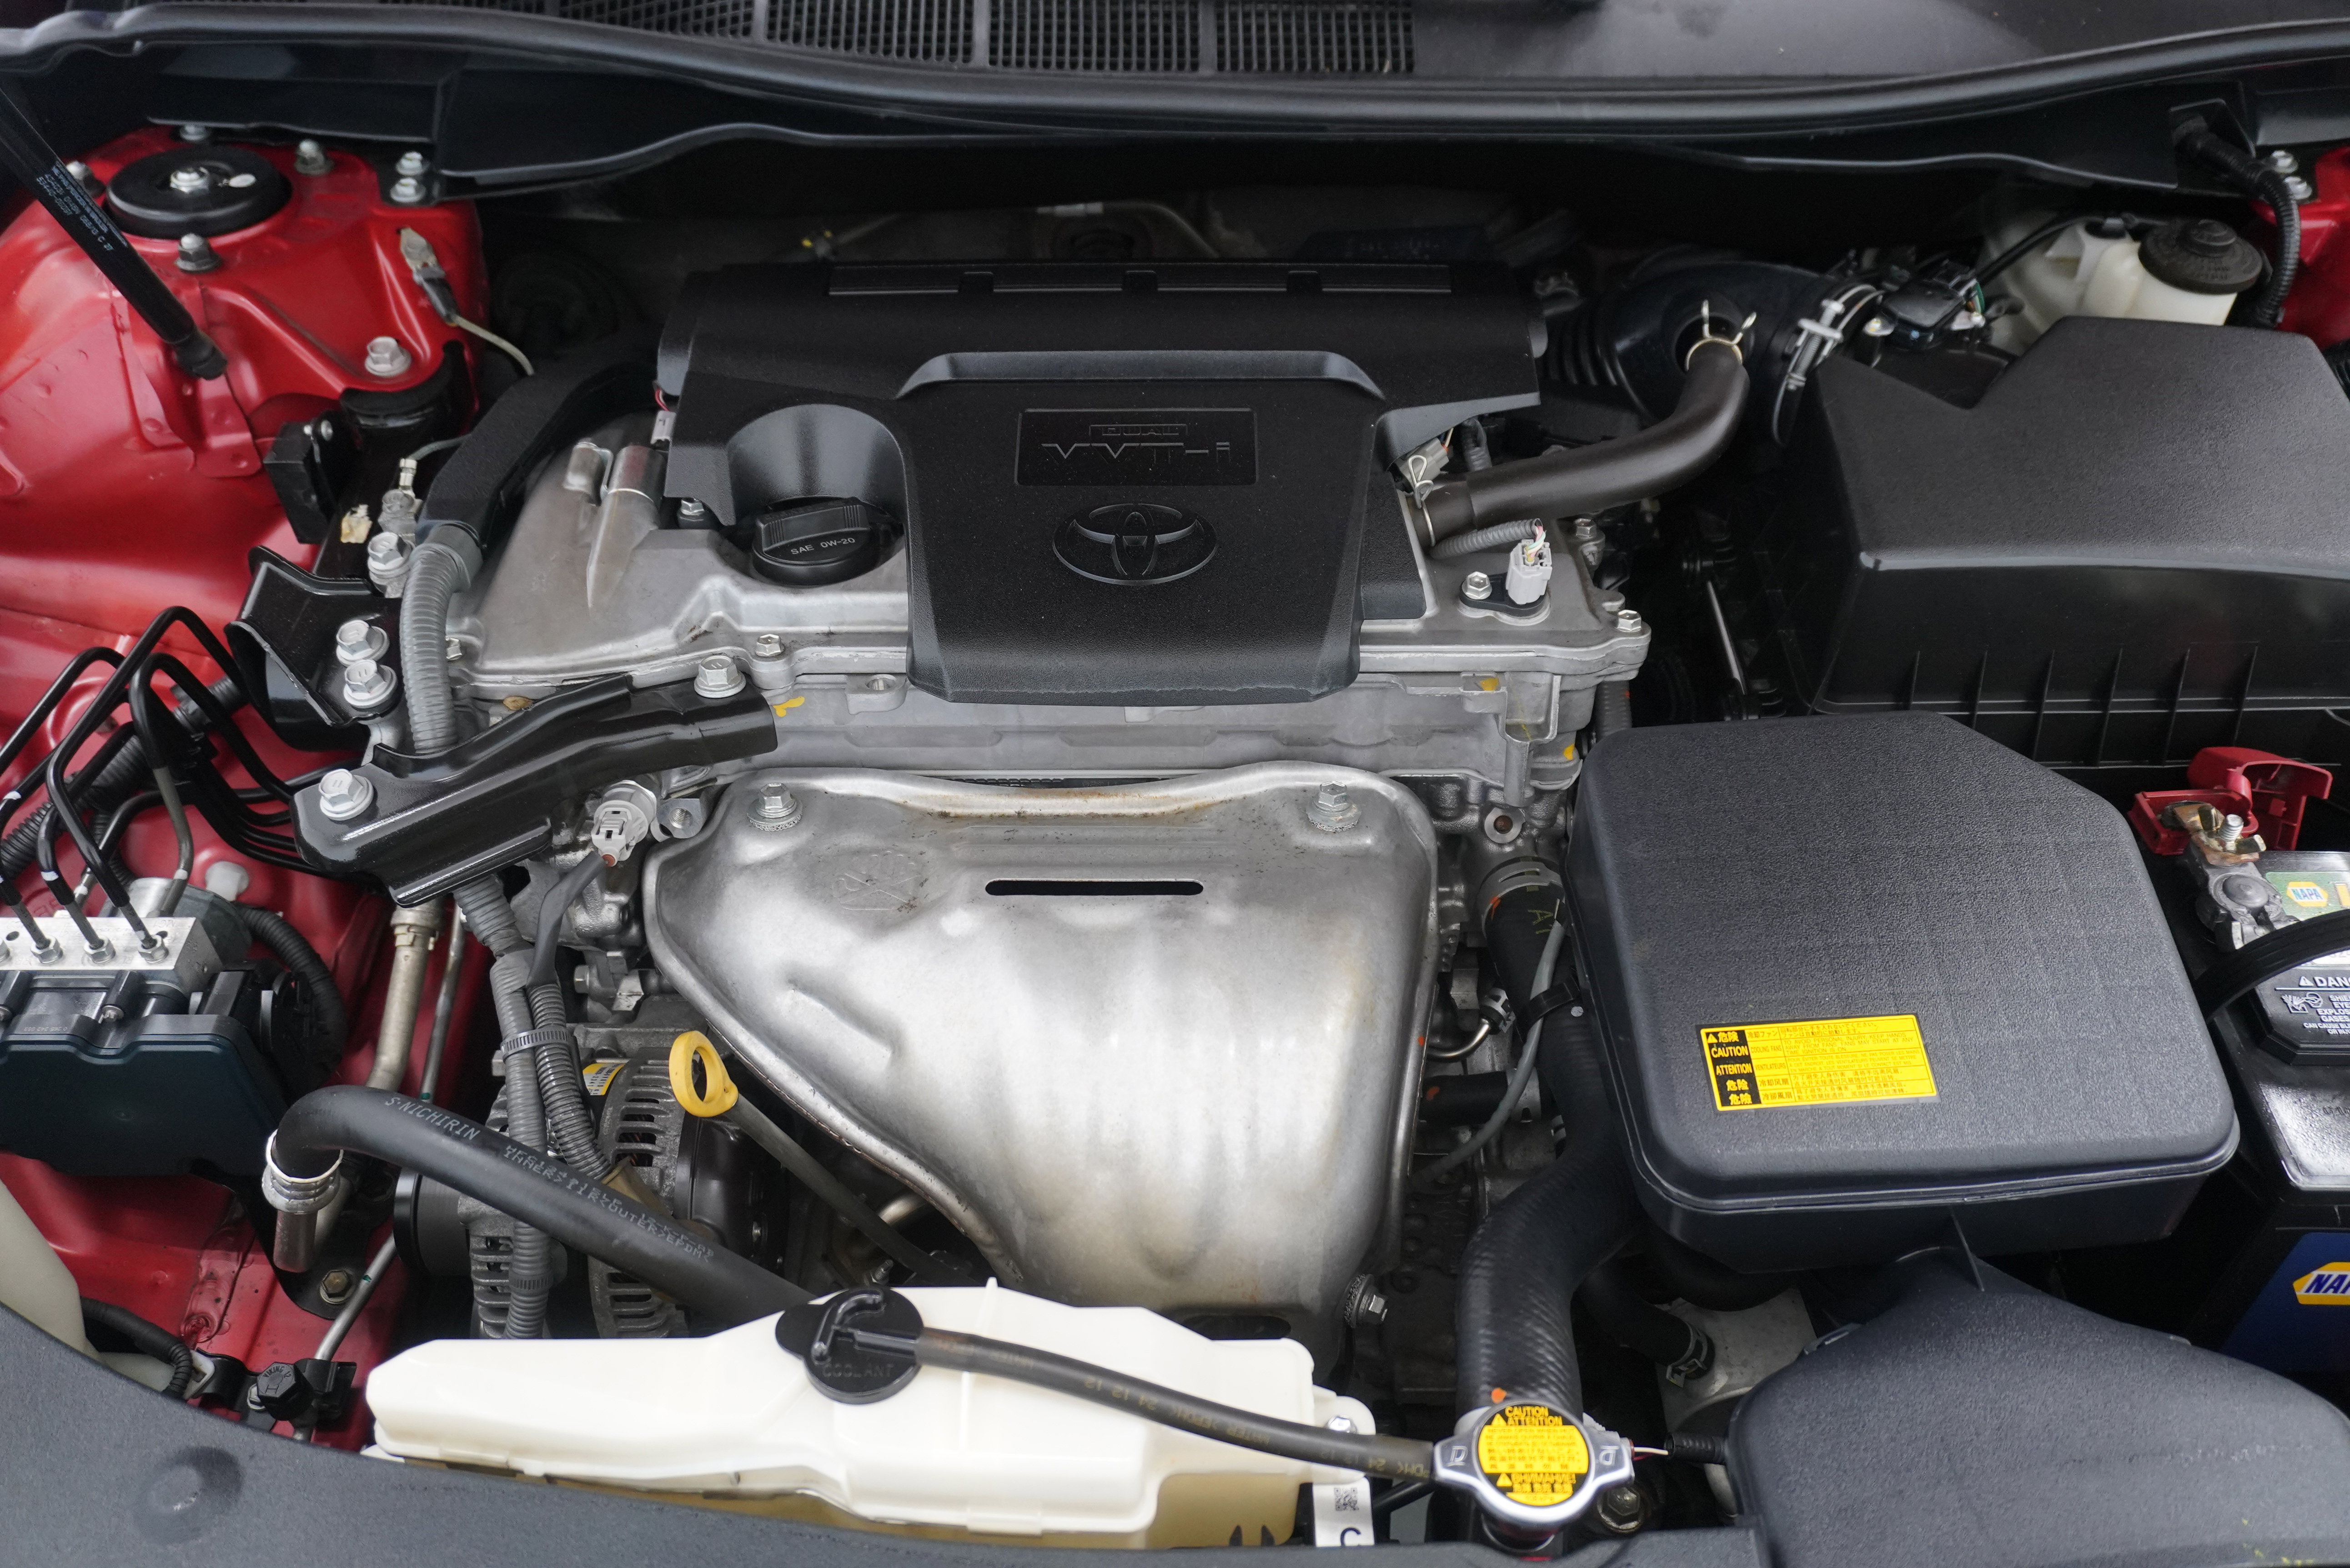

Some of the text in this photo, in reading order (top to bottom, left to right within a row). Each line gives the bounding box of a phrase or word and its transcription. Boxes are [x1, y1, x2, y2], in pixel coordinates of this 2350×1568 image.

[1101, 425, 1180, 436] DUAL
[1041, 442, 1231, 464] VVT-i
[790, 537, 856, 555] SAE 0W-20
[2290, 887, 2324, 900] NAPA
[2314, 976, 2350, 987] DAN
[1710, 1045, 1749, 1058] CAUTION
[1714, 1063, 1752, 1075] ATTENTION
[262, 1365, 285, 1377] VIKING
[821, 1362, 894, 1378] COOLANT
[1505, 1406, 1549, 1417] CAUTION
[1507, 1416, 1562, 1426] ATTENTION
